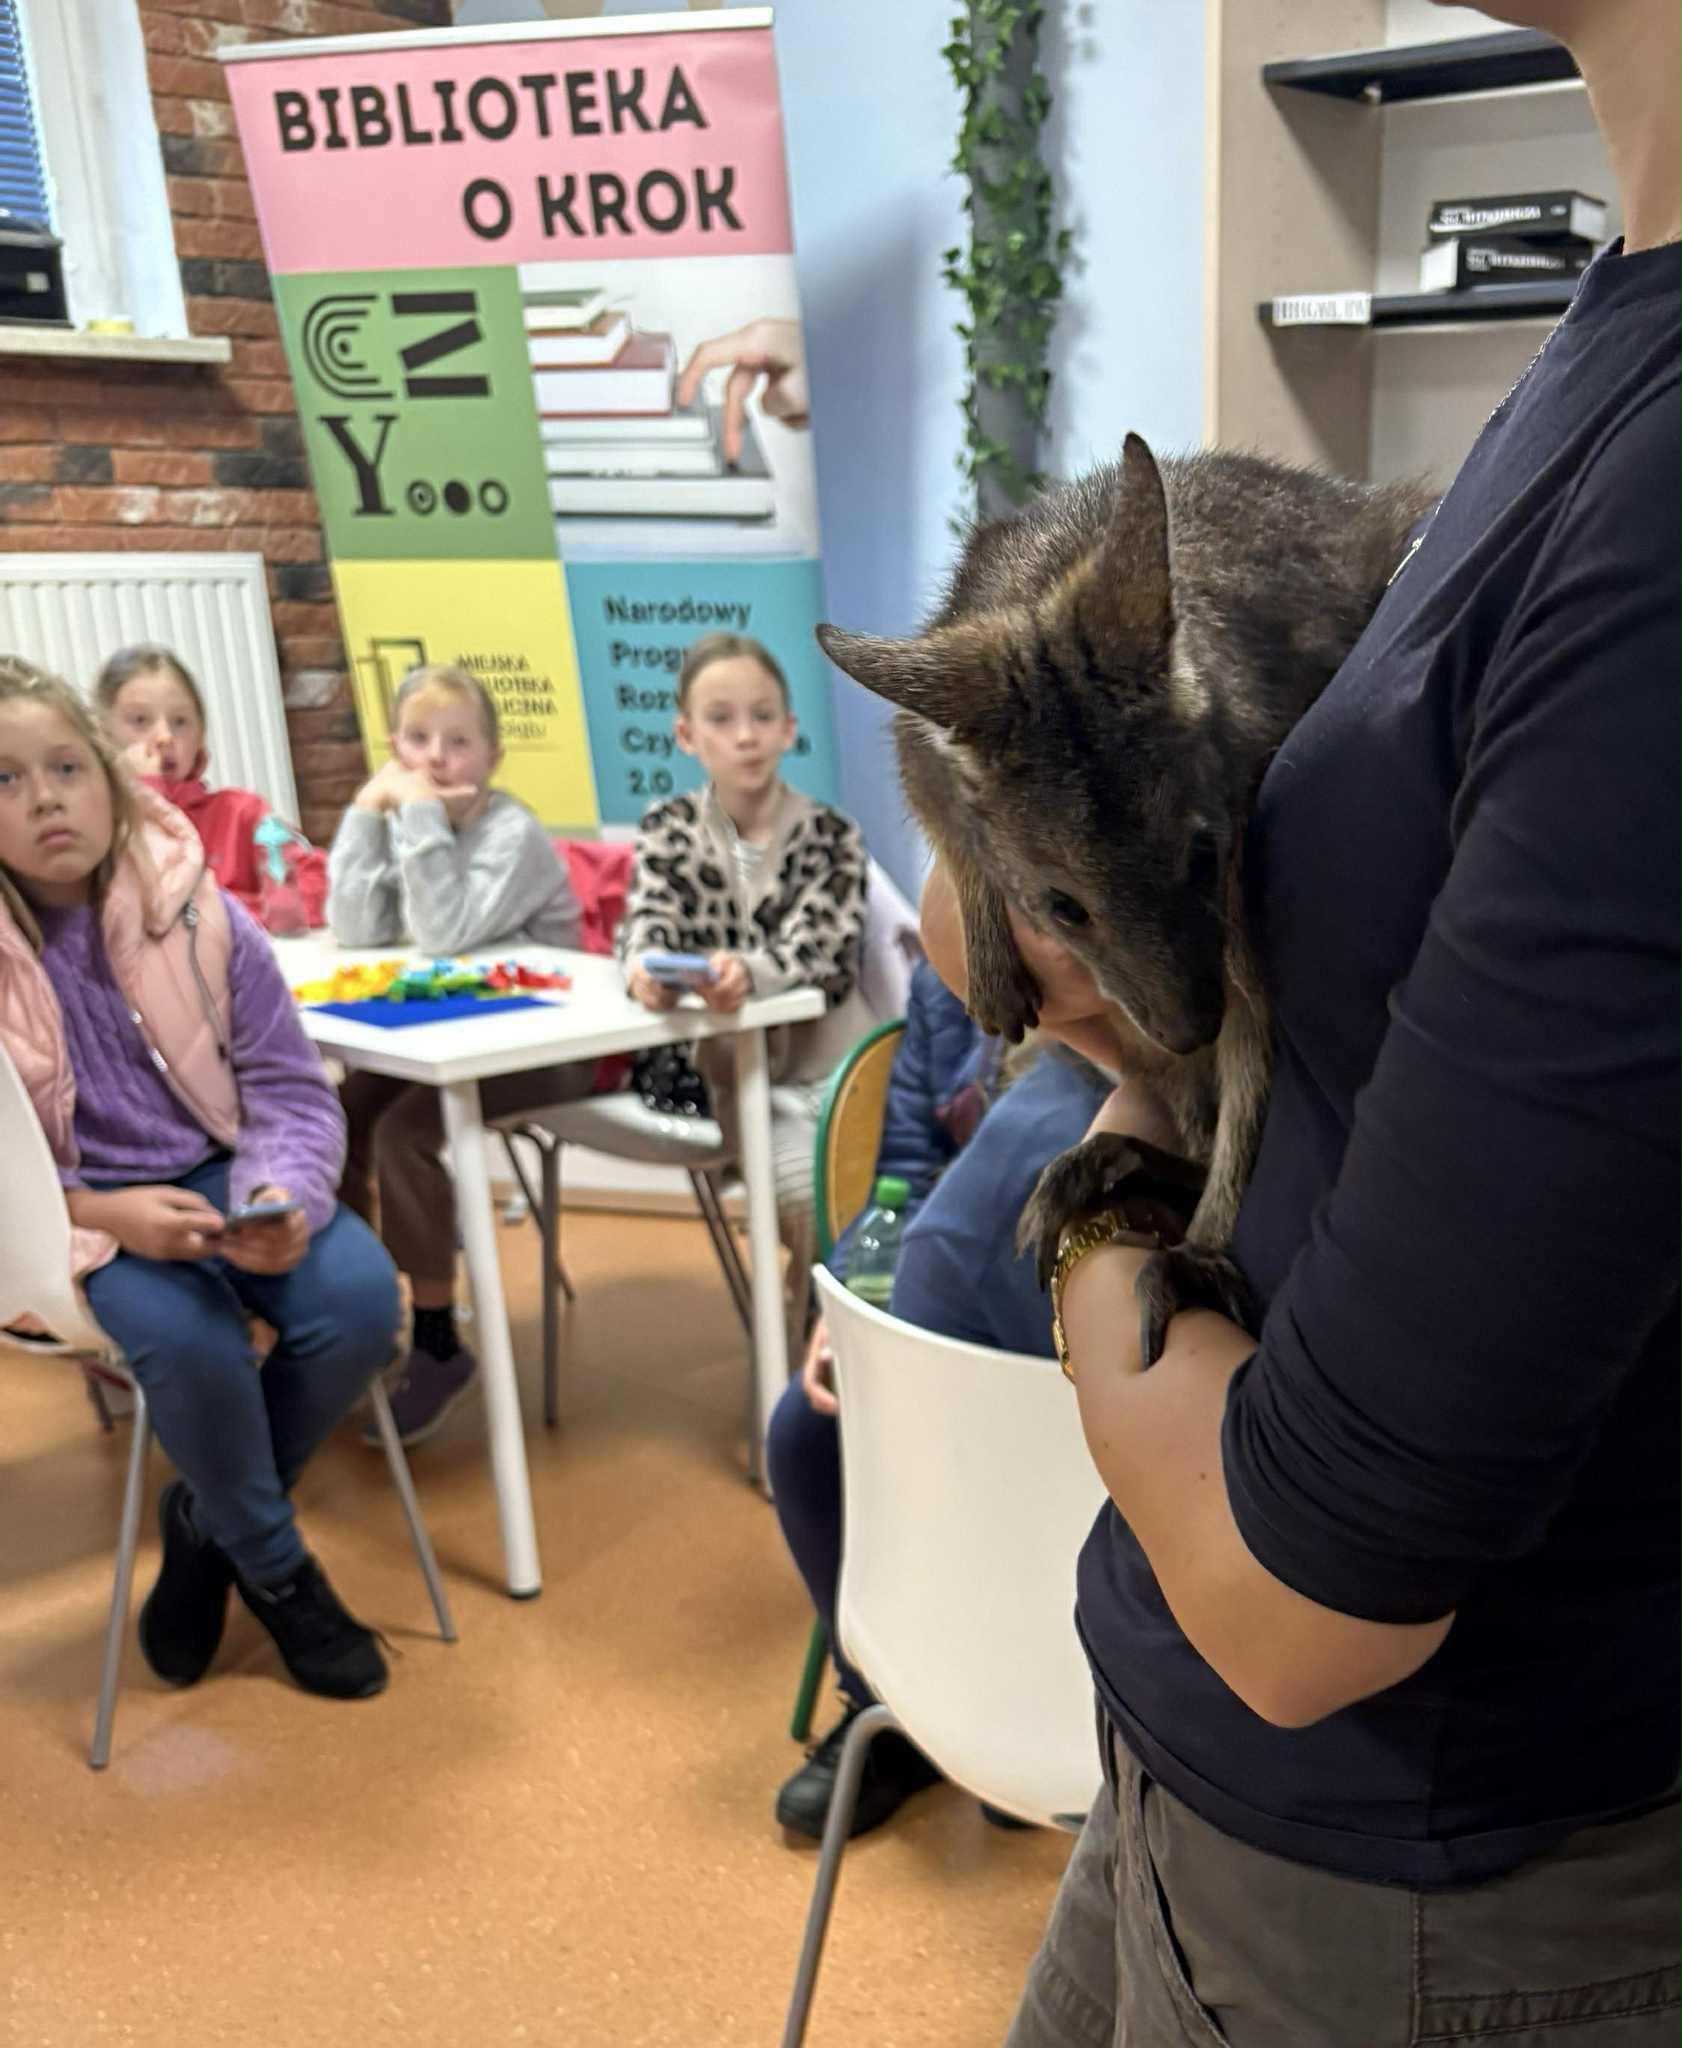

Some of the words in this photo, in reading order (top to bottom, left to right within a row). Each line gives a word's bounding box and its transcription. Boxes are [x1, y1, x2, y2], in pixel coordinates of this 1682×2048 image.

[274, 66, 707, 152] BIBLIOTEKA
[462, 178, 513, 240] O
[537, 167, 744, 238] KROK
[603, 595, 751, 629] Narodowy
[629, 768, 674, 795] 2.0
